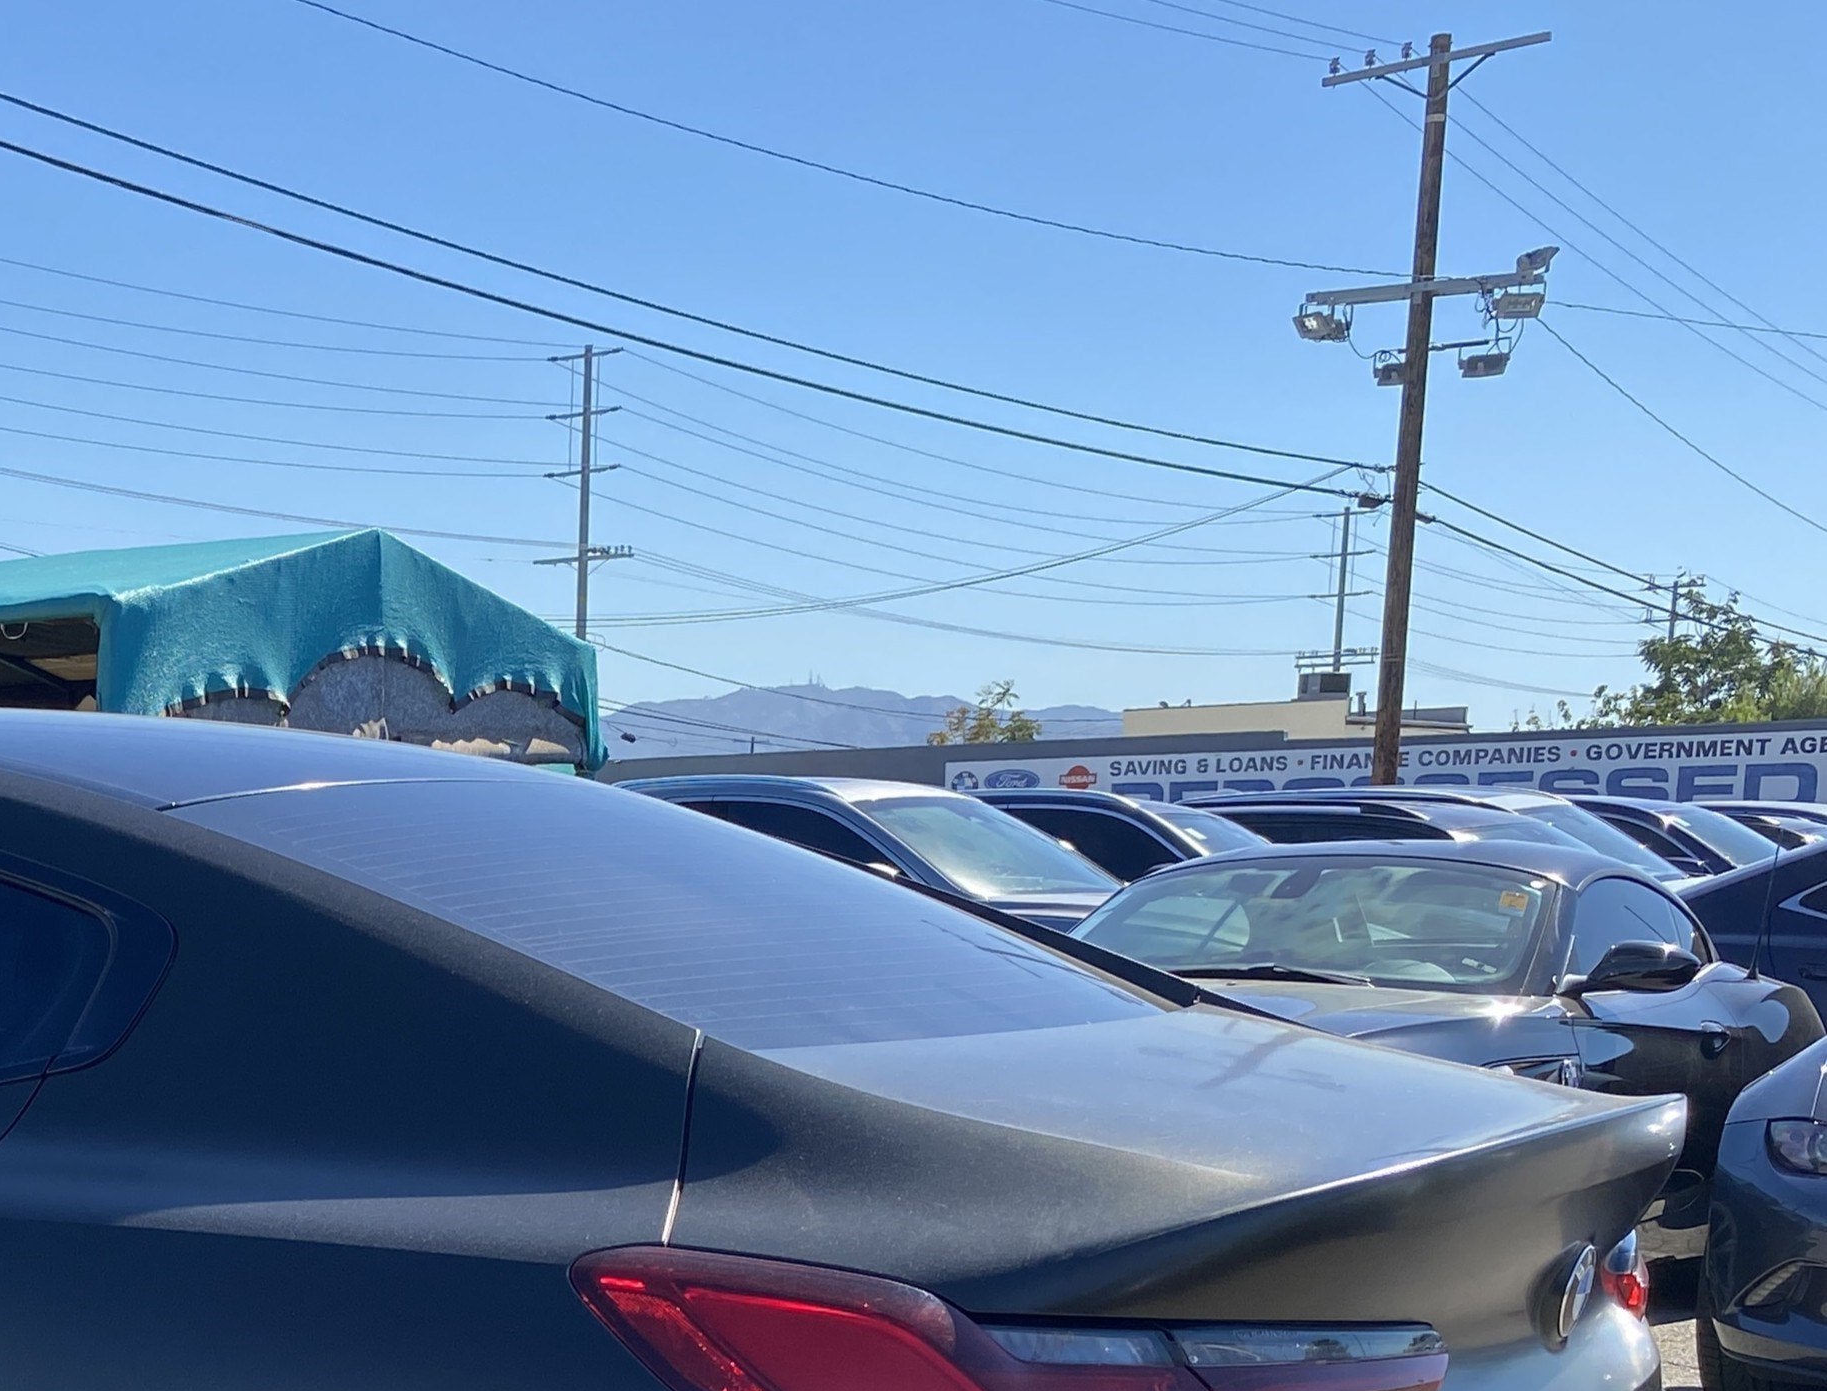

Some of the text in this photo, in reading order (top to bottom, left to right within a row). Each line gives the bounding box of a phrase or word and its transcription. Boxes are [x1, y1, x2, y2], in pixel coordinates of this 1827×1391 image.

[1110, 758, 1187, 777] SAVING
[1196, 758, 1209, 773] &
[1216, 756, 1288, 773] LOANS
[1310, 750, 1409, 770] FINANE
[1418, 746, 1561, 767] COMPANIES
[1586, 737, 1772, 761] GOVERNMENT
[1060, 774, 1096, 785] NISSAN
